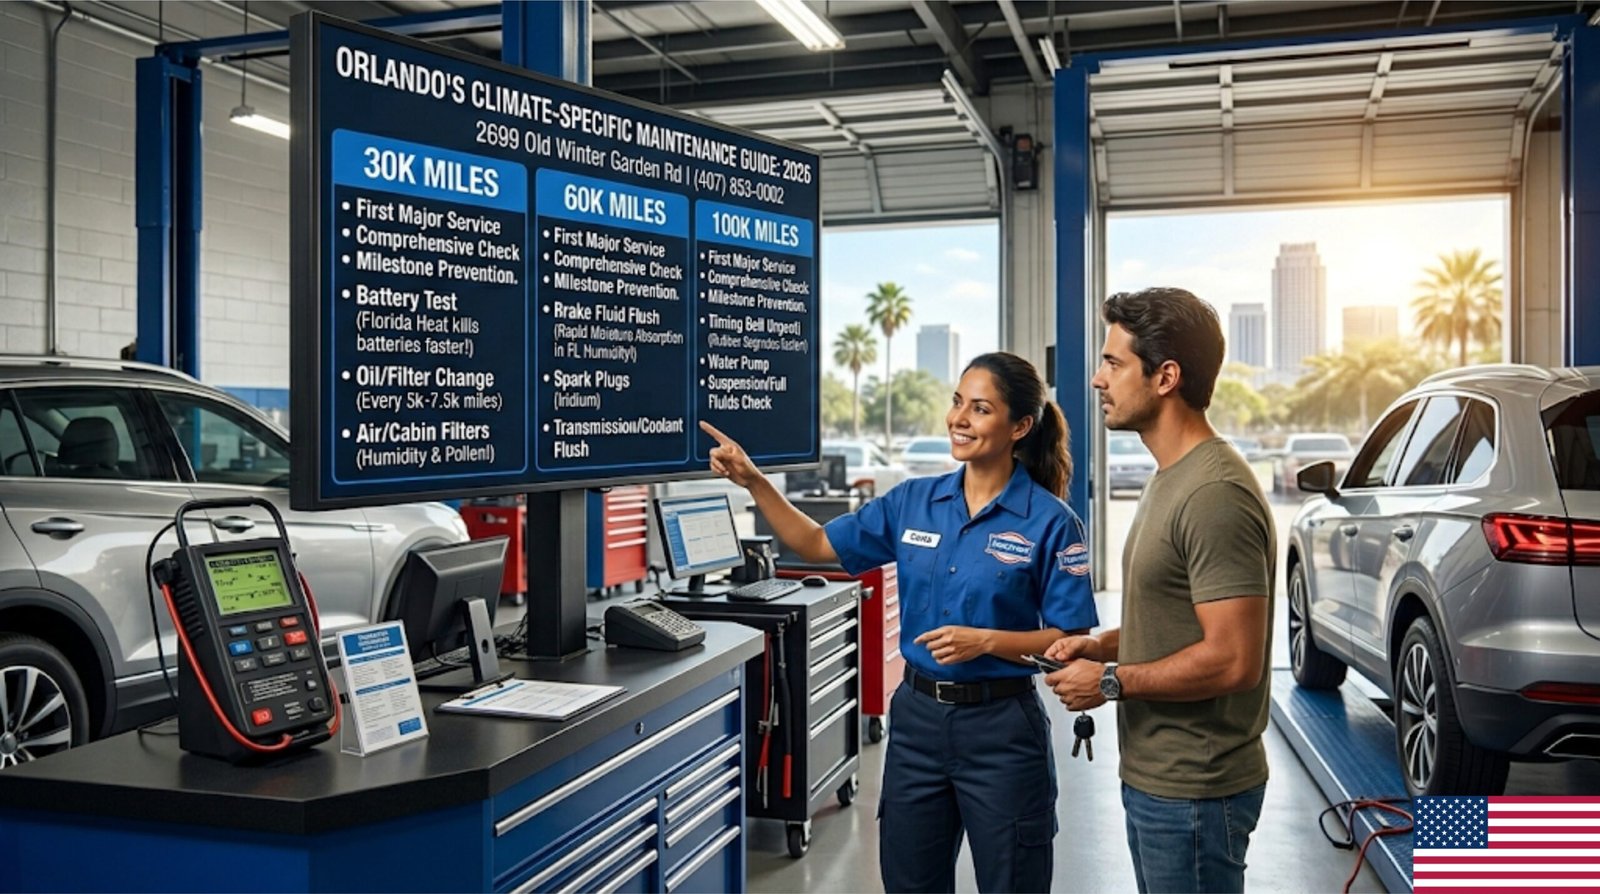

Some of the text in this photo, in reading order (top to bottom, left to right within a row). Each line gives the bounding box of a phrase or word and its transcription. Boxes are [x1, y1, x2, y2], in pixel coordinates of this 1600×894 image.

[335, 46, 812, 185] ORLANDO'S CLIMATE-SPECIFIC MAINTENANCE GUIDE: 2026
[363, 146, 500, 198] 30K MILES
[475, 120, 520, 151] 2699
[524, 130, 552, 156] Old
[556, 136, 607, 167] Winter
[611, 150, 661, 180] Garden
[664, 162, 683, 184] Rd
[694, 169, 727, 197] (407)
[729, 175, 785, 205] 853-0002
[356, 198, 501, 235] First Major Service
[564, 183, 667, 226] 60K MILES
[712, 211, 800, 248] 100K MILES
[356, 225, 520, 261] Comprehensive Check
[554, 227, 665, 258] First Major Service
[356, 251, 519, 285] Milestone Prevention.
[554, 250, 682, 280] Comprehensive Check
[708, 249, 796, 274] First Major Service
[356, 284, 458, 312] Battery Test
[554, 272, 680, 301] Milestone Prevention.
[708, 288, 755, 307] Milestone
[356, 311, 480, 334] (Florida Heat kills
[554, 301, 660, 325] Brake Fluid Flush
[708, 313, 743, 333] Timing
[554, 323, 588, 341] (Rapid
[356, 333, 474, 358] batteries faster!)
[554, 342, 564, 357] in
[567, 342, 581, 358] FL
[707, 353, 770, 375] Water Pump
[356, 365, 495, 391] Oil/Filter Change
[554, 369, 631, 391] Spark Plugs
[356, 391, 503, 413] (Every 5k-7.5k miles)
[554, 391, 601, 411] (Iridium)
[741, 394, 772, 410] Check
[356, 421, 490, 444] Air/Cabin Filters
[553, 417, 684, 436] Transmission/Coolant
[356, 447, 427, 471] (Humidity
[431, 447, 441, 464] &
[554, 440, 589, 459] Flush
